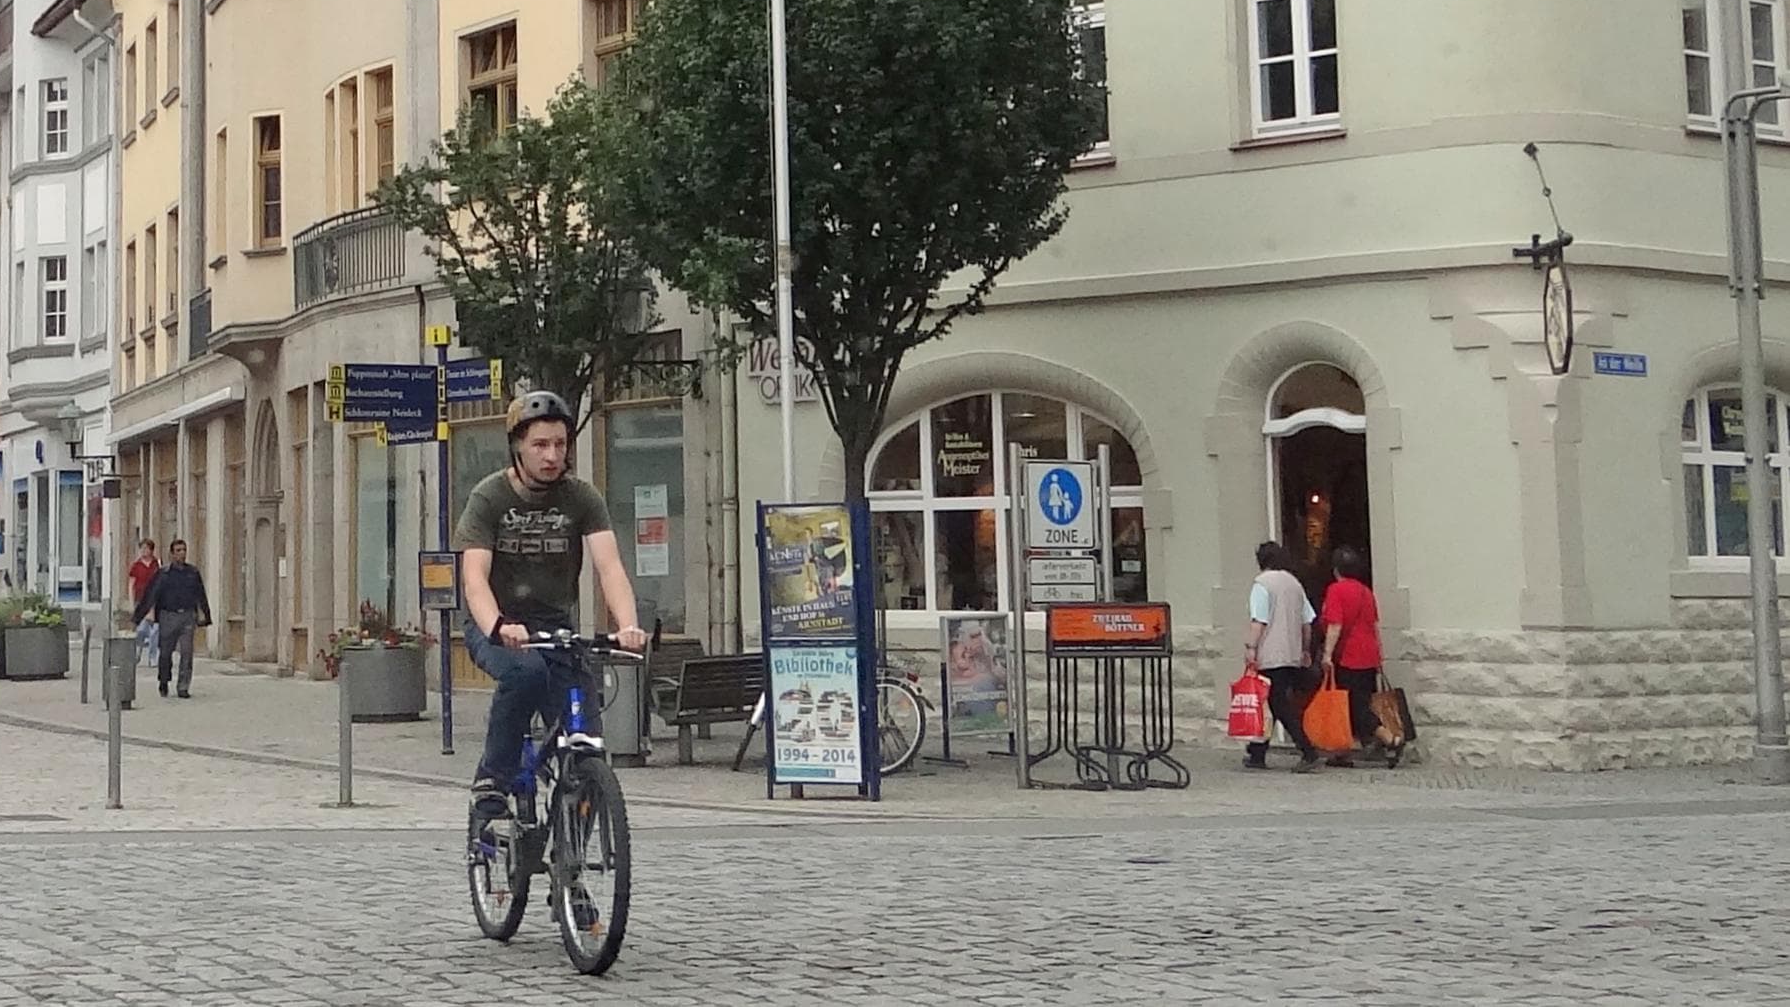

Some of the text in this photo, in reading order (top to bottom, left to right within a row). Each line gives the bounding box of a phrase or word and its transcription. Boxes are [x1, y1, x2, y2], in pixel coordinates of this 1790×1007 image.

[760, 374, 811, 399] OIK
[1017, 444, 1038, 458] hris
[943, 459, 981, 477] Meister
[1045, 529, 1079, 543] ZONE
[774, 657, 853, 675] Bibliothek
[777, 748, 810, 762] 1994
[822, 749, 856, 763] 2014
